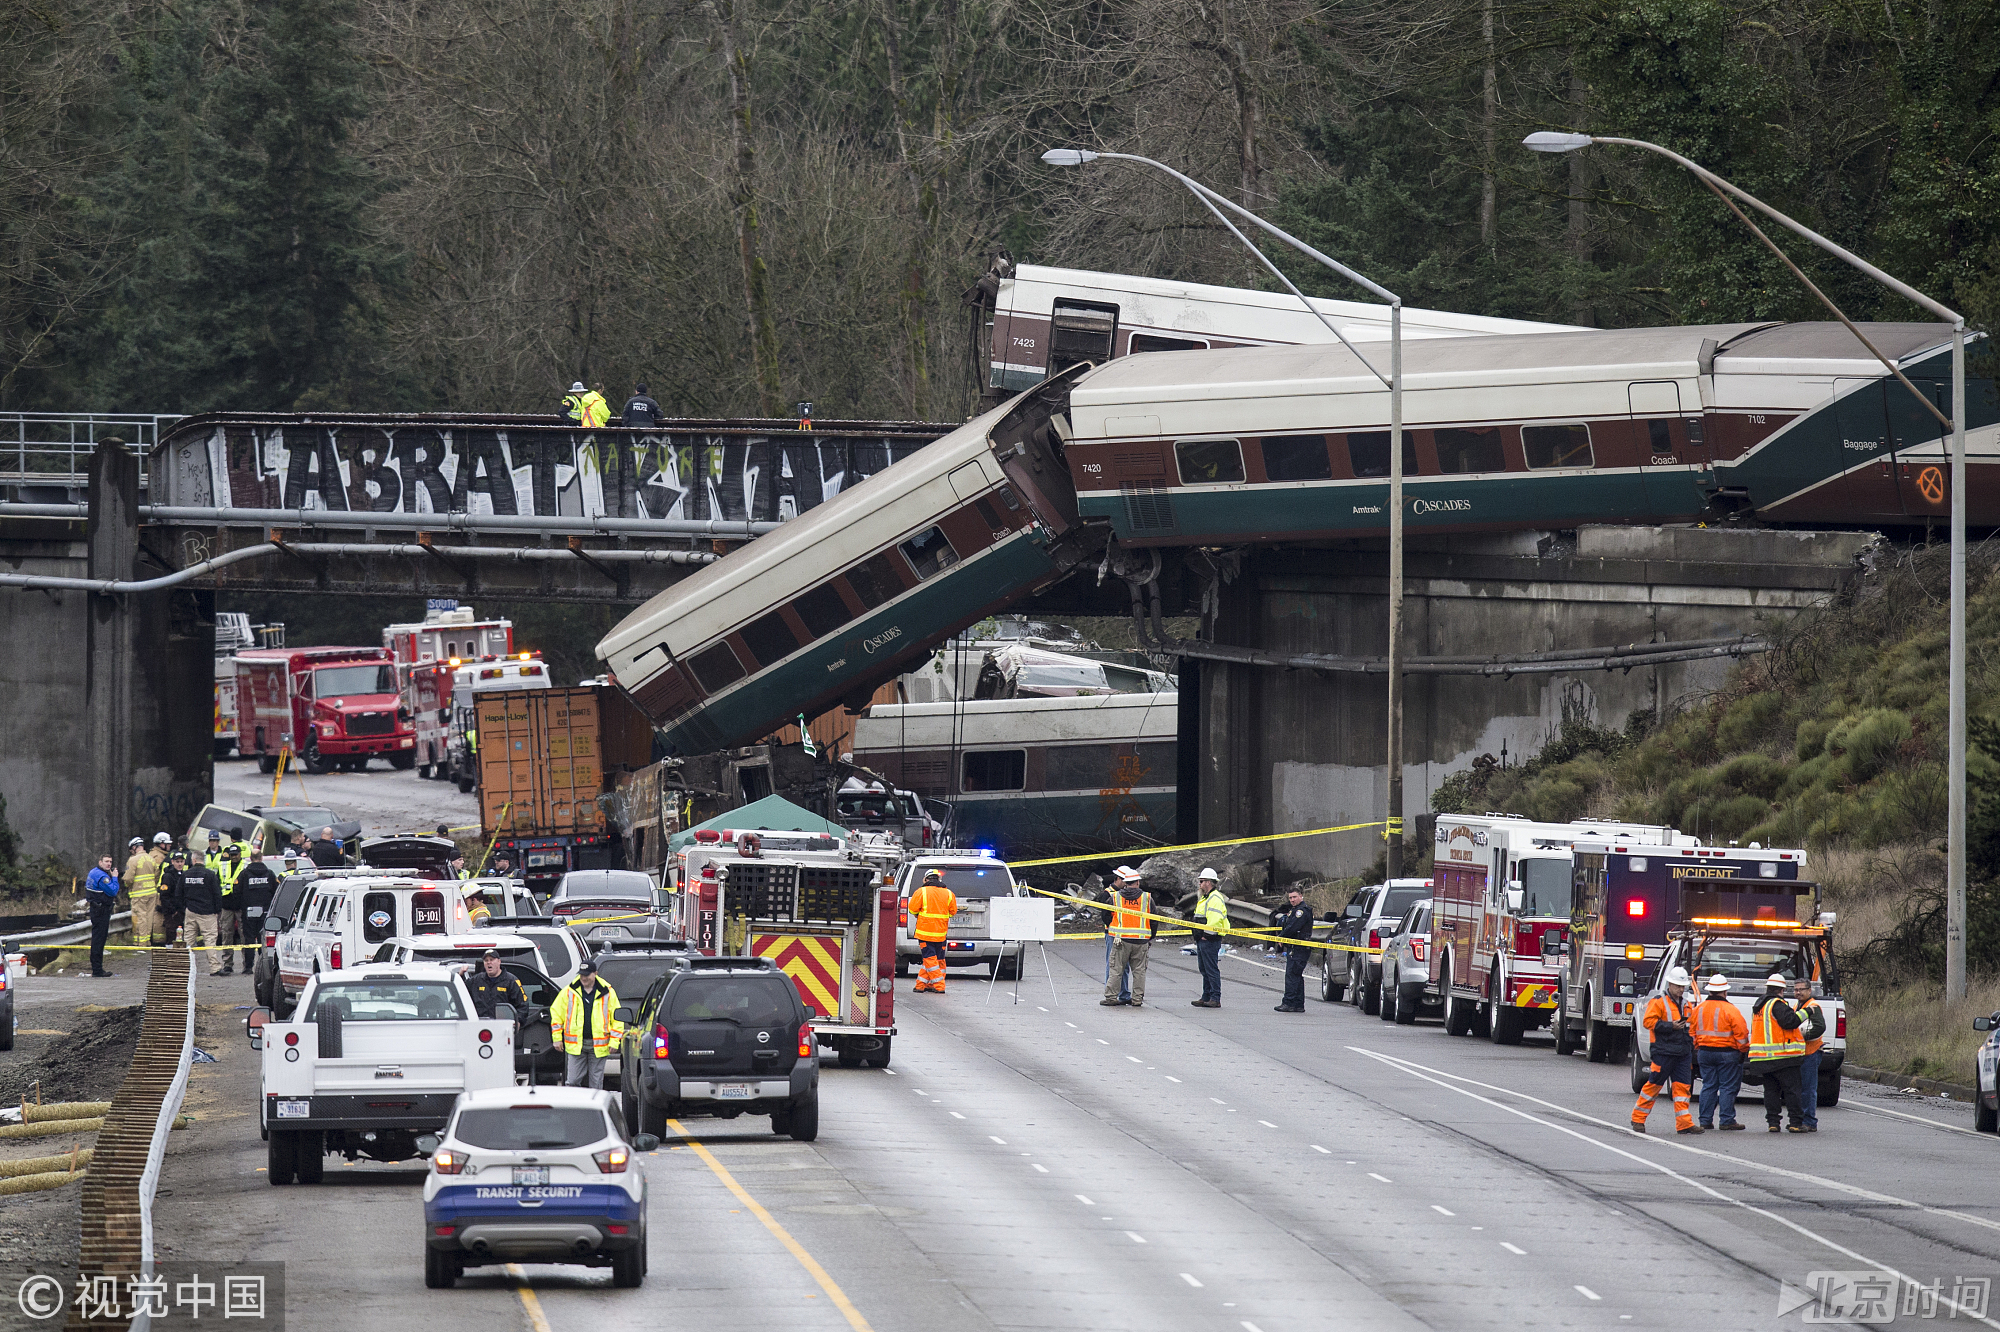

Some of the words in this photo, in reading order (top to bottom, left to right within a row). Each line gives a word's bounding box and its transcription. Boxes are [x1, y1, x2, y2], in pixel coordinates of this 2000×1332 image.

[1013, 337, 1035, 348] 7423
[1747, 415, 1766, 424] 7102
[1843, 439, 1878, 451] Baggage
[1651, 455, 1678, 465] Coach
[1082, 463, 1102, 473] 7420
[1352, 505, 1380, 514] Amtrak
[992, 526, 1012, 541] Coach
[428, 599, 458, 609] SOUTH
[826, 658, 847, 673] Amtrak
[485, 713, 529, 723] Hapa-Lloyd
[1122, 814, 1148, 823] Amtrak
[1672, 867, 1734, 879] INCIDENT
[1124, 898, 1139, 906] FRA
[418, 911, 439, 922] B-101
[703, 912, 713, 921] E
[476, 1187, 524, 1199] TRANSIT
[528, 1187, 584, 1198] SECURITY
